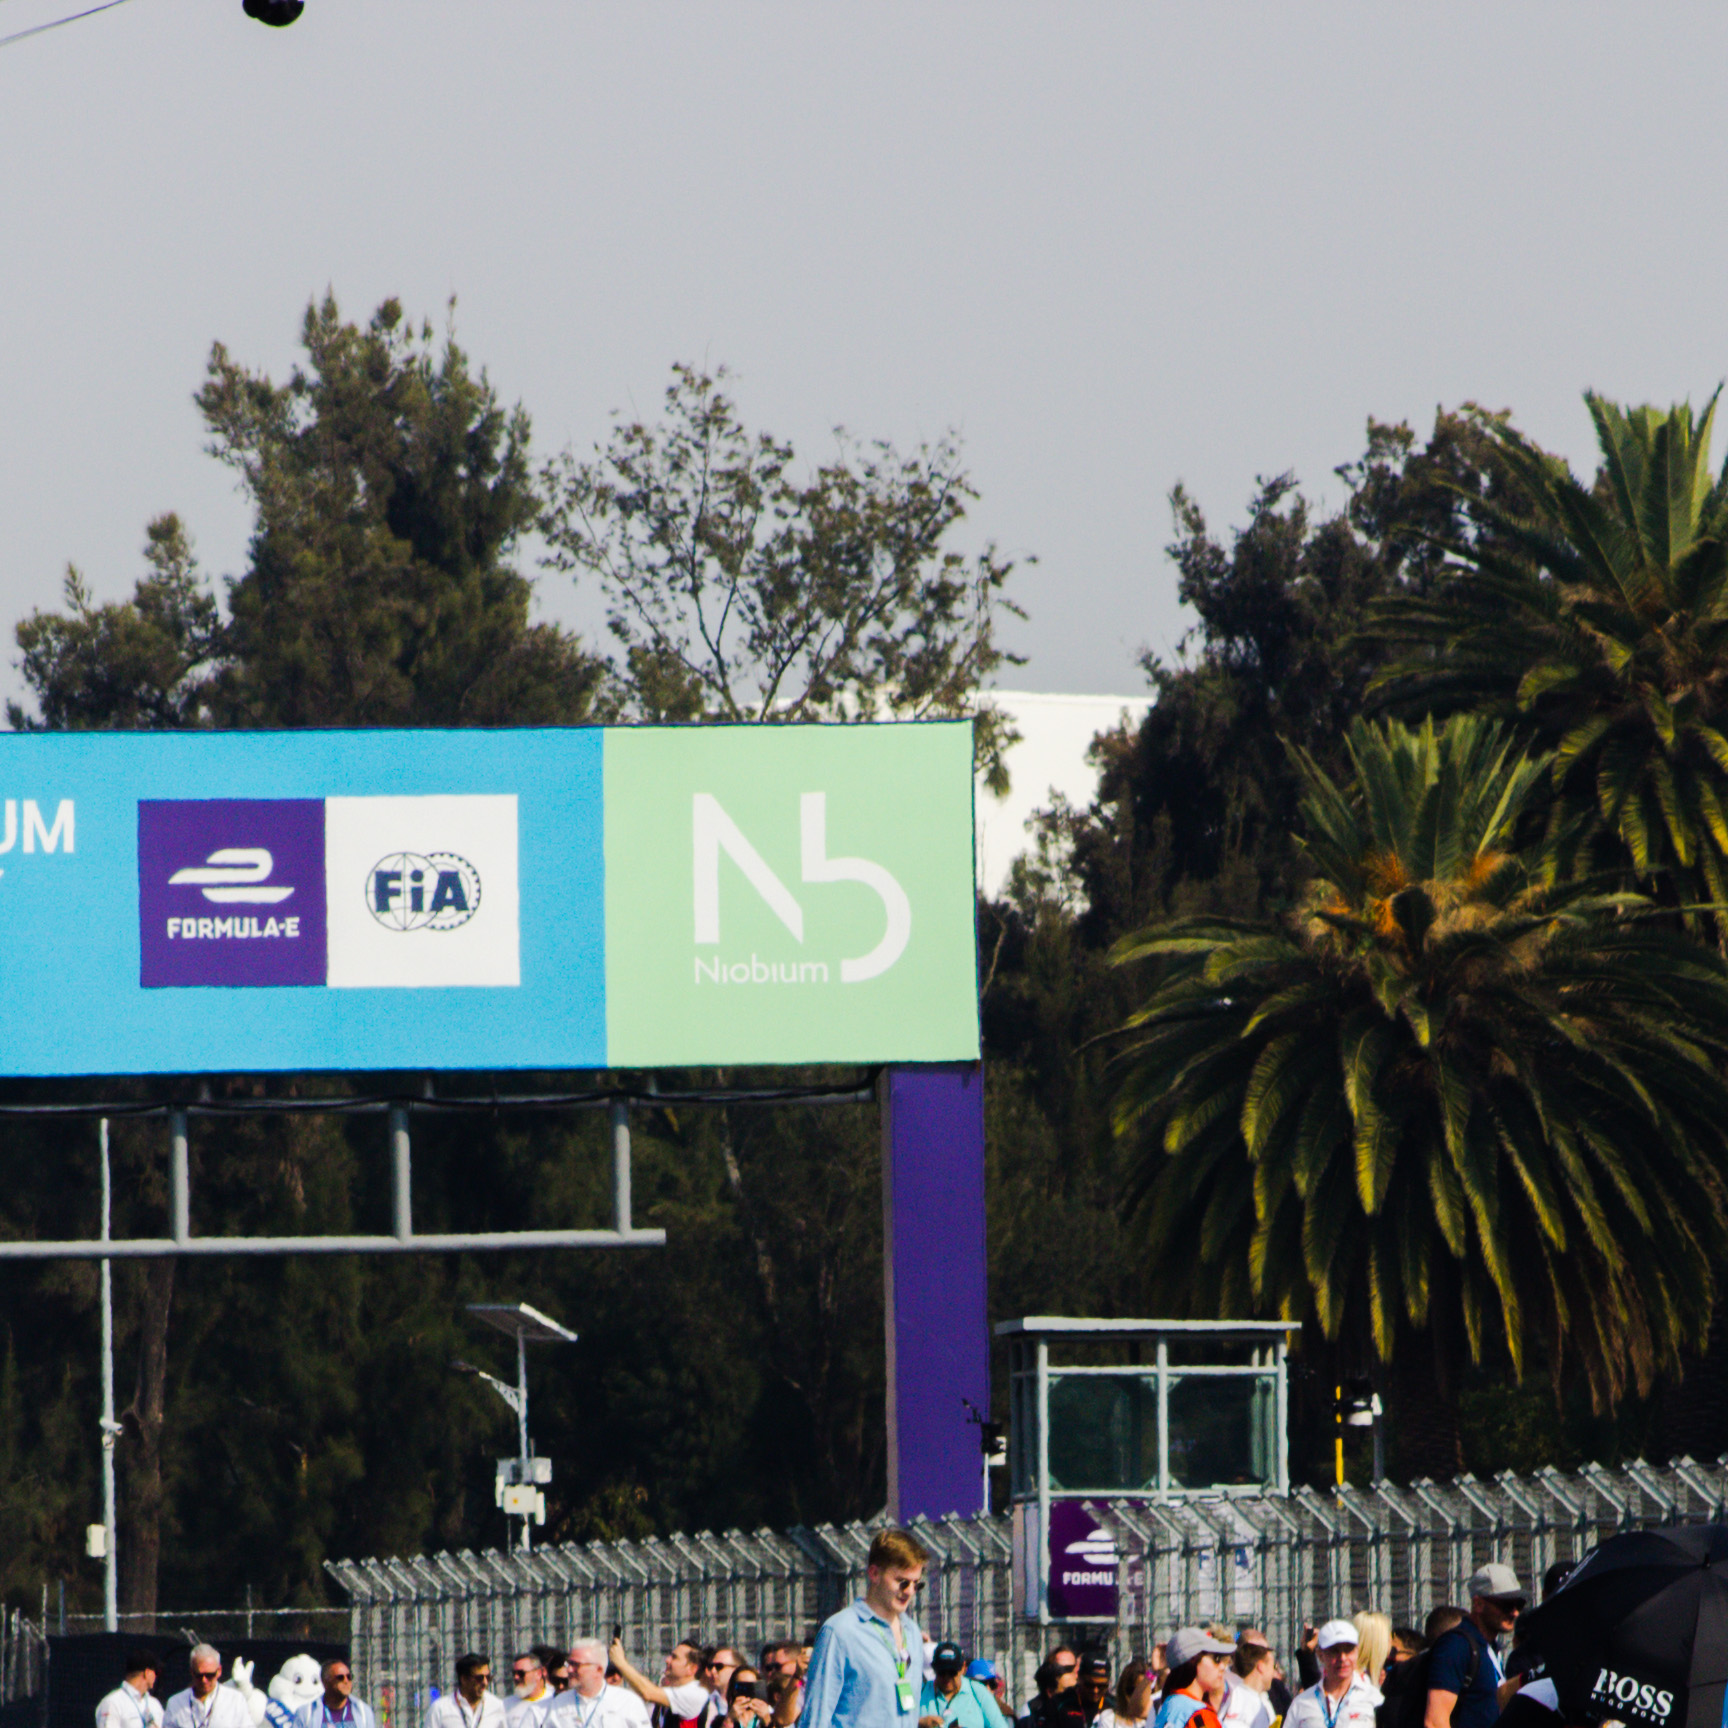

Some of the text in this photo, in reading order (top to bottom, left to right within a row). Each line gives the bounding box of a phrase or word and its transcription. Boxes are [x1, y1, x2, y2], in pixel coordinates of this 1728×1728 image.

[167, 916, 301, 940] FORMULA-E
[694, 952, 829, 985] Niobium
[1592, 1667, 1674, 1717] BOSS
